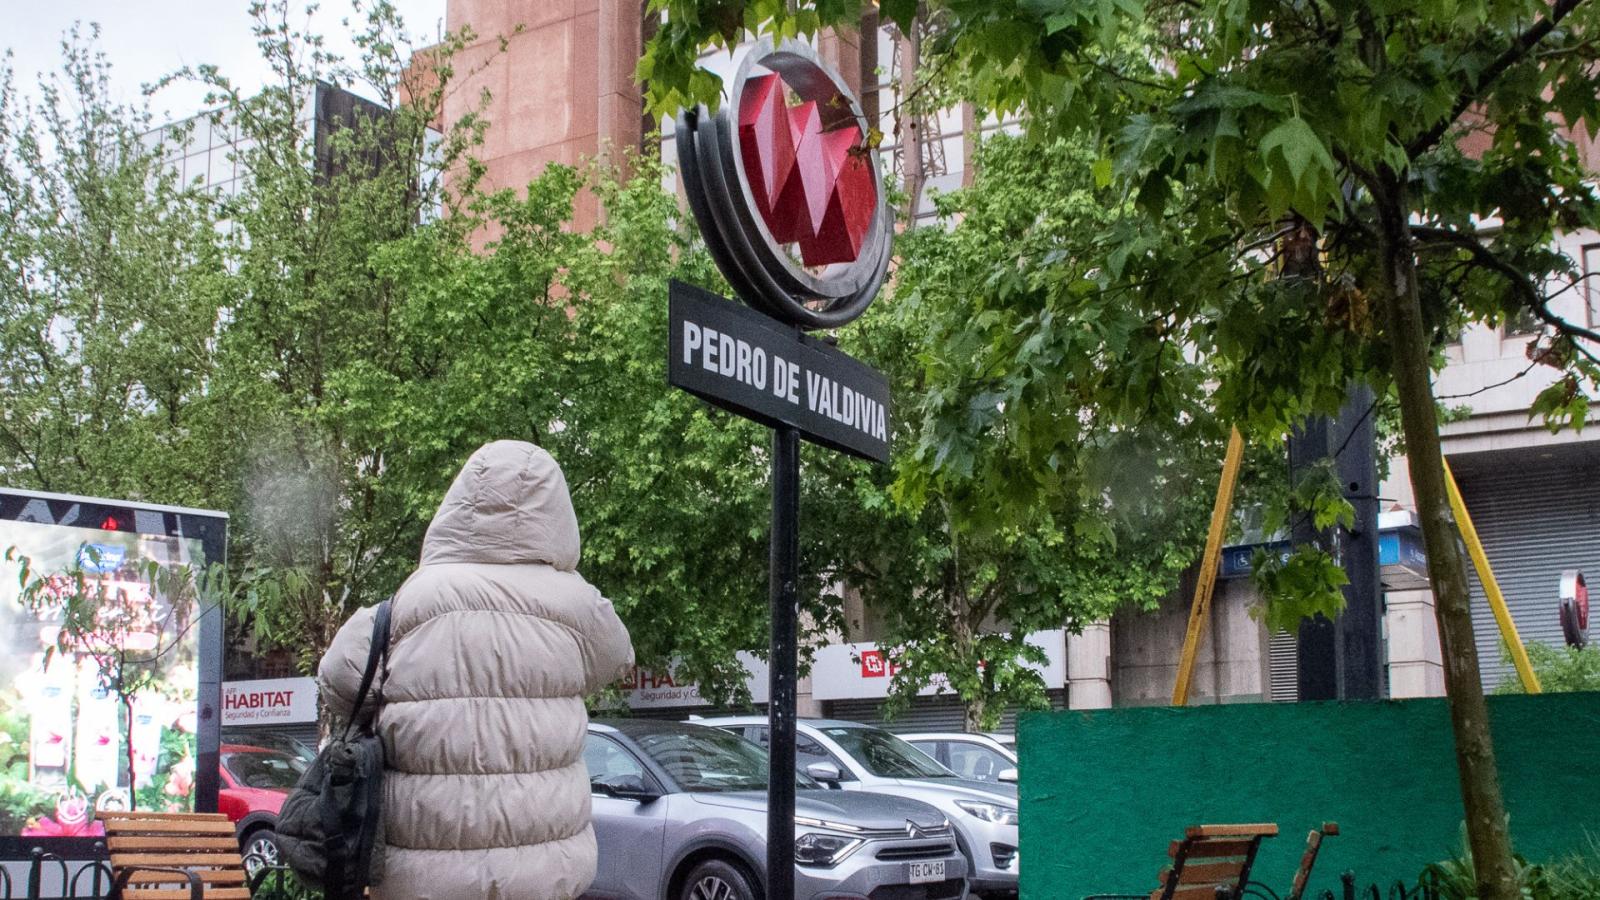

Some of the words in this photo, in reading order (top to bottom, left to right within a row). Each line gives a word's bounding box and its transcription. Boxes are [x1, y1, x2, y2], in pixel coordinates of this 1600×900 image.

[683, 320, 767, 390] PEDRO
[773, 355, 800, 405] DE
[806, 369, 887, 442] VALDIVIA
[225, 691, 294, 709] HABITAT
[640, 689, 681, 701] Seguridad
[684, 691, 689, 700] y
[225, 710, 255, 720] Seguridad
[260, 708, 291, 718] Confianza
